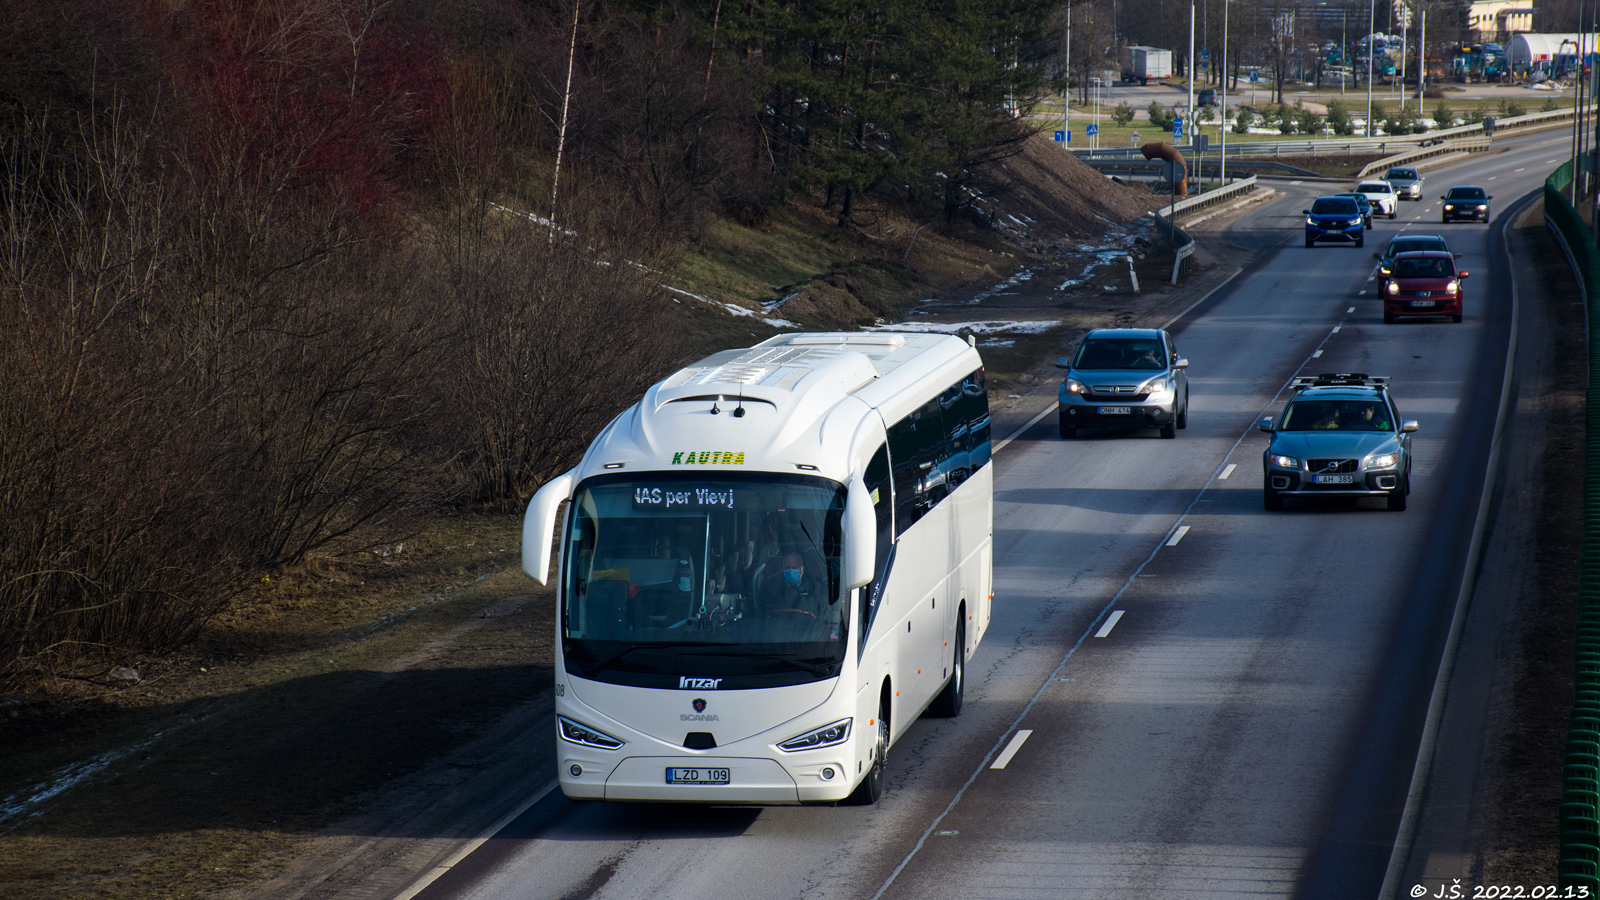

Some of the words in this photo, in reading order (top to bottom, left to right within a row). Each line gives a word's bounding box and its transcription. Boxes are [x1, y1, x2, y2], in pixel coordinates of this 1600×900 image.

[671, 451, 744, 465] KAUTRA
[1317, 475, 1334, 483] LAH
[665, 491, 692, 508] per
[679, 676, 723, 690] Irizar
[680, 713, 720, 722] SCANIA
[674, 769, 699, 781] LZD
[707, 769, 727, 781] 109
